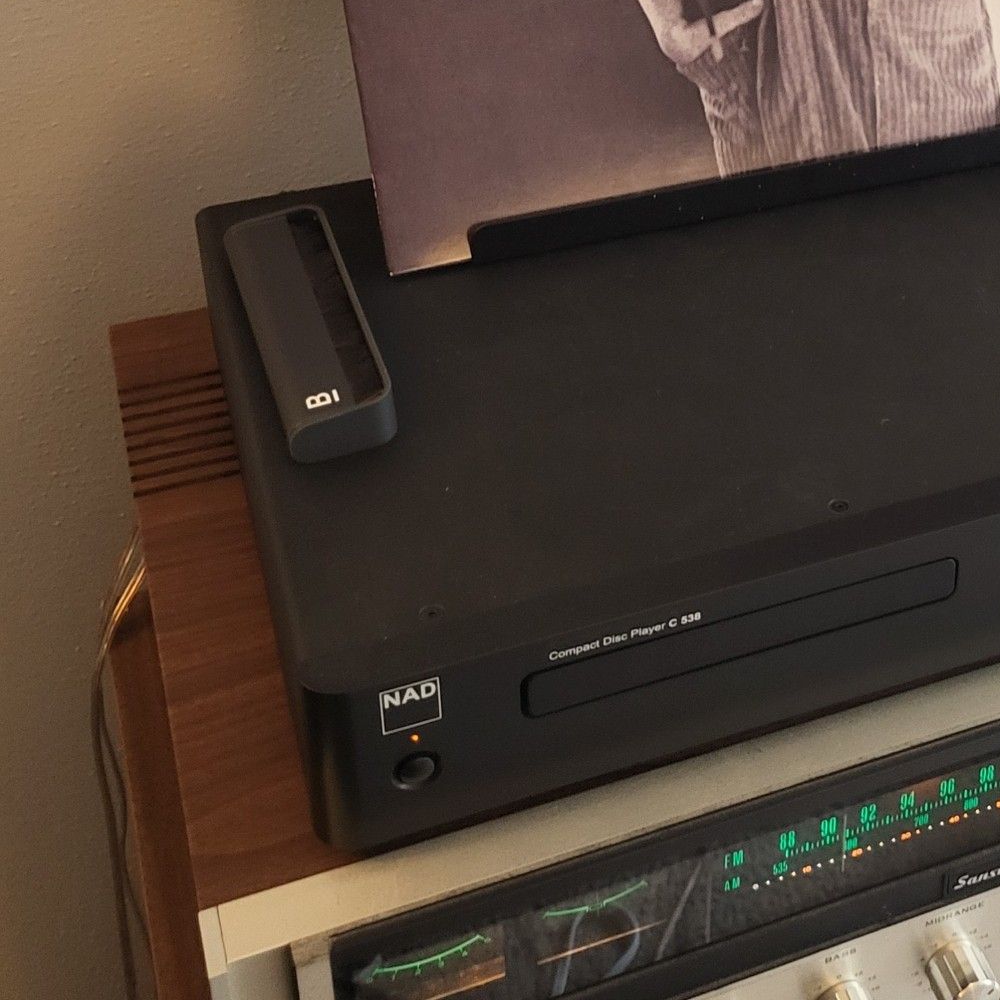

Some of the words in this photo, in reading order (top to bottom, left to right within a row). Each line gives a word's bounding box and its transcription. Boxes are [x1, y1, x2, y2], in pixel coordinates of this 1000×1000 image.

[549, 640, 601, 662] Compact
[603, 630, 628, 647] Disc
[630, 622, 666, 640] Player
[668, 618, 678, 629] C
[681, 612, 702, 625] 538
[383, 681, 437, 710] NAD
[723, 849, 745, 870] FM
[779, 830, 797, 851] 88
[820, 816, 838, 837] 90
[860, 804, 878, 824] 92
[900, 791, 916, 810] 94
[979, 764, 995, 783] 98
[723, 877, 741, 892] AM
[924, 900, 985, 928] MIDRANGE
